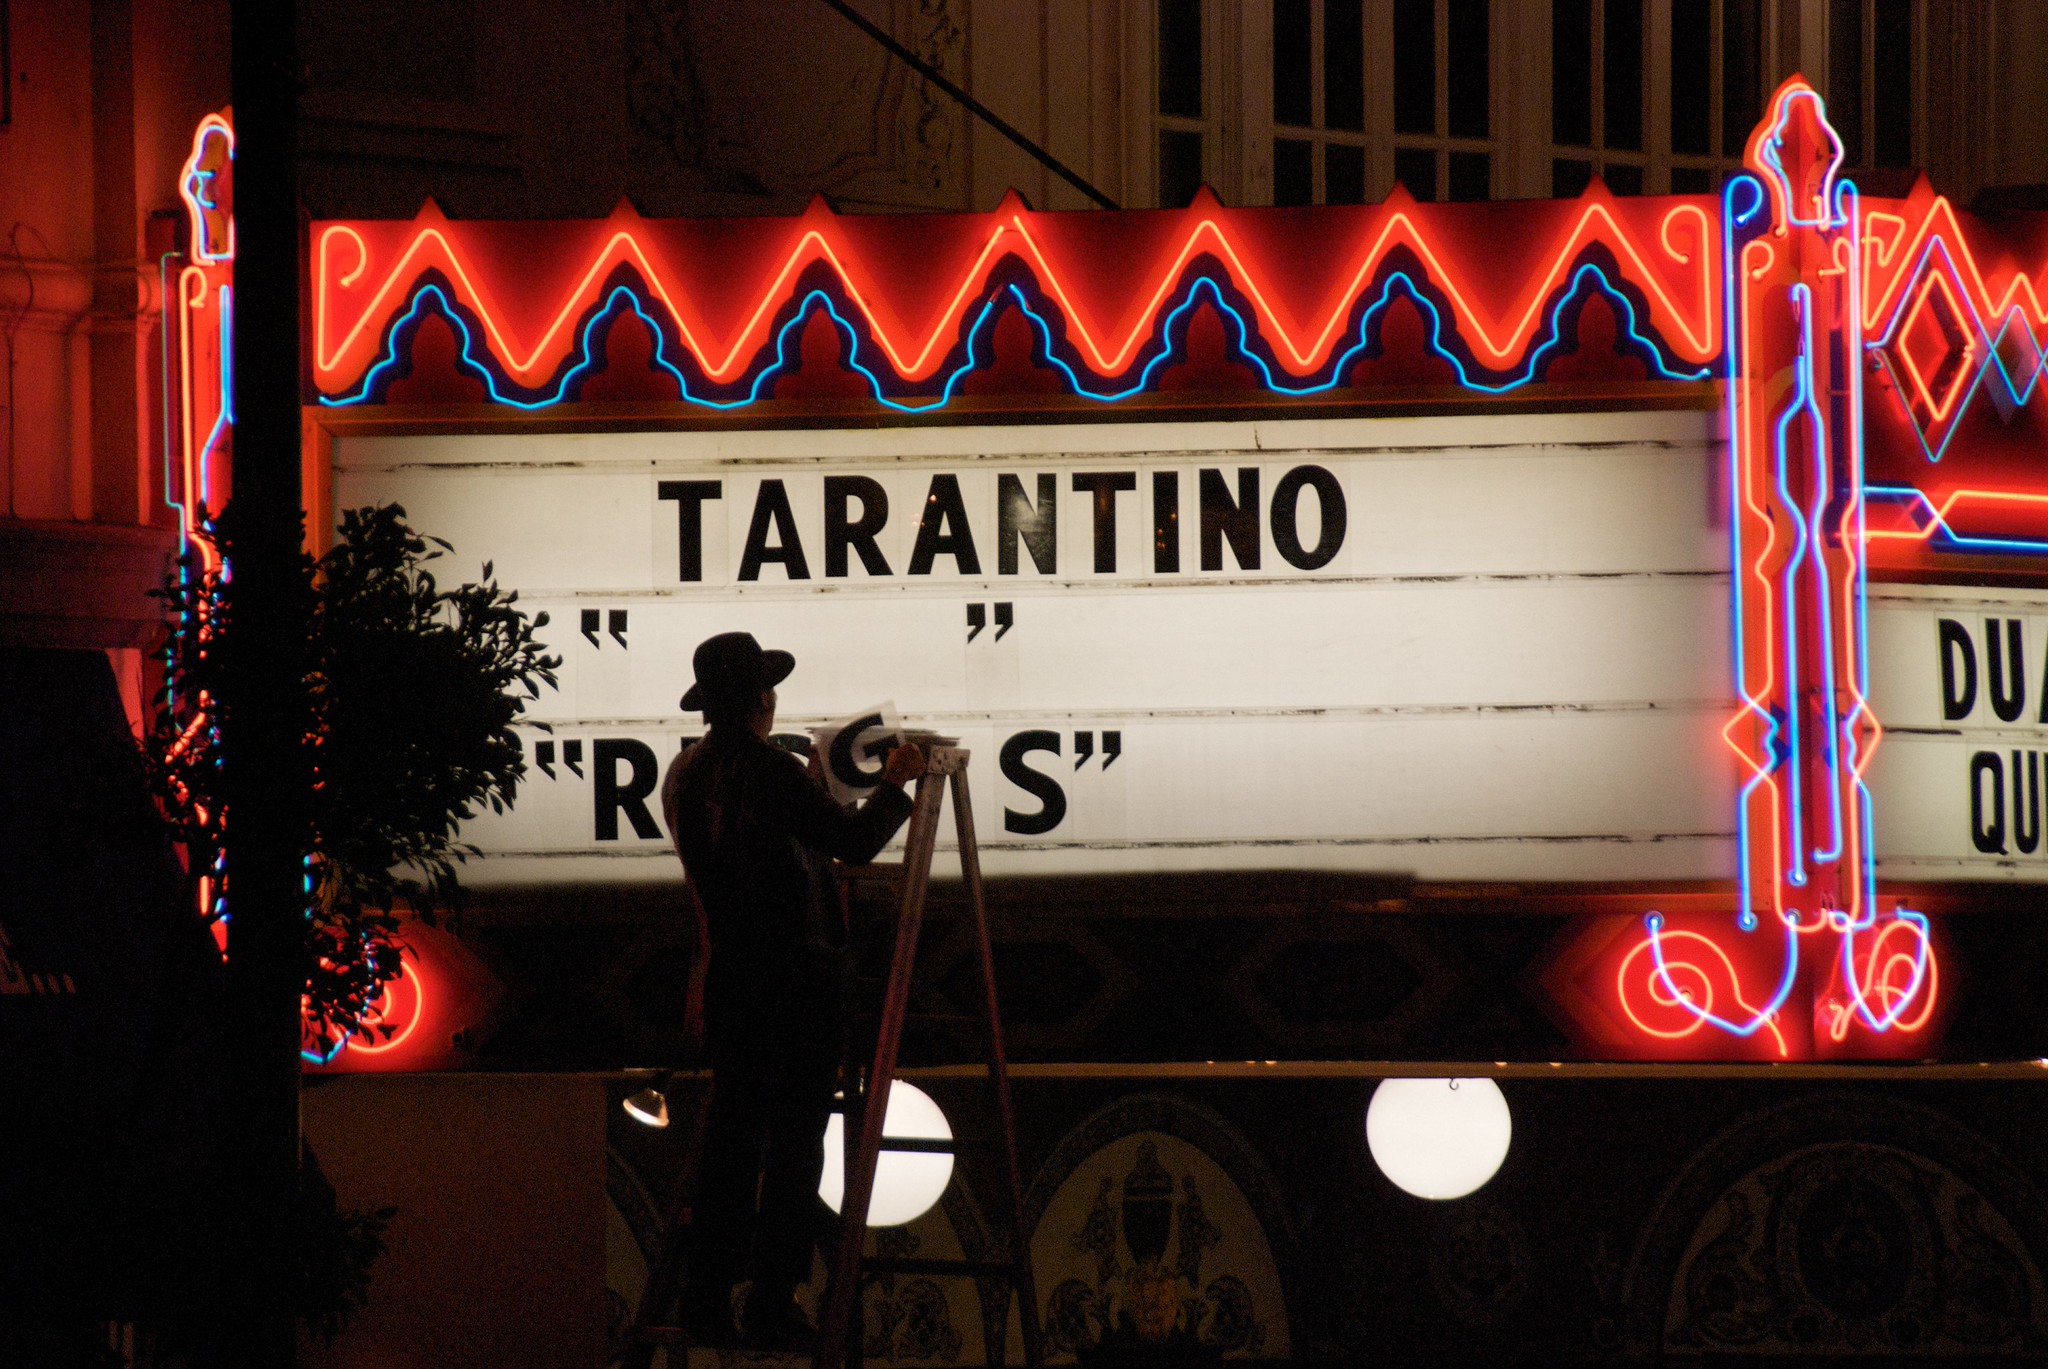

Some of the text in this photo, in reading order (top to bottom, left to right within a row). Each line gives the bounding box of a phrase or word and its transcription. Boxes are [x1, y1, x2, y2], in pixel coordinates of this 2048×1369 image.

[657, 464, 1347, 582] TARANTINO
[1938, 618, 2048, 723] DU
[1970, 749, 2048, 855] QU
